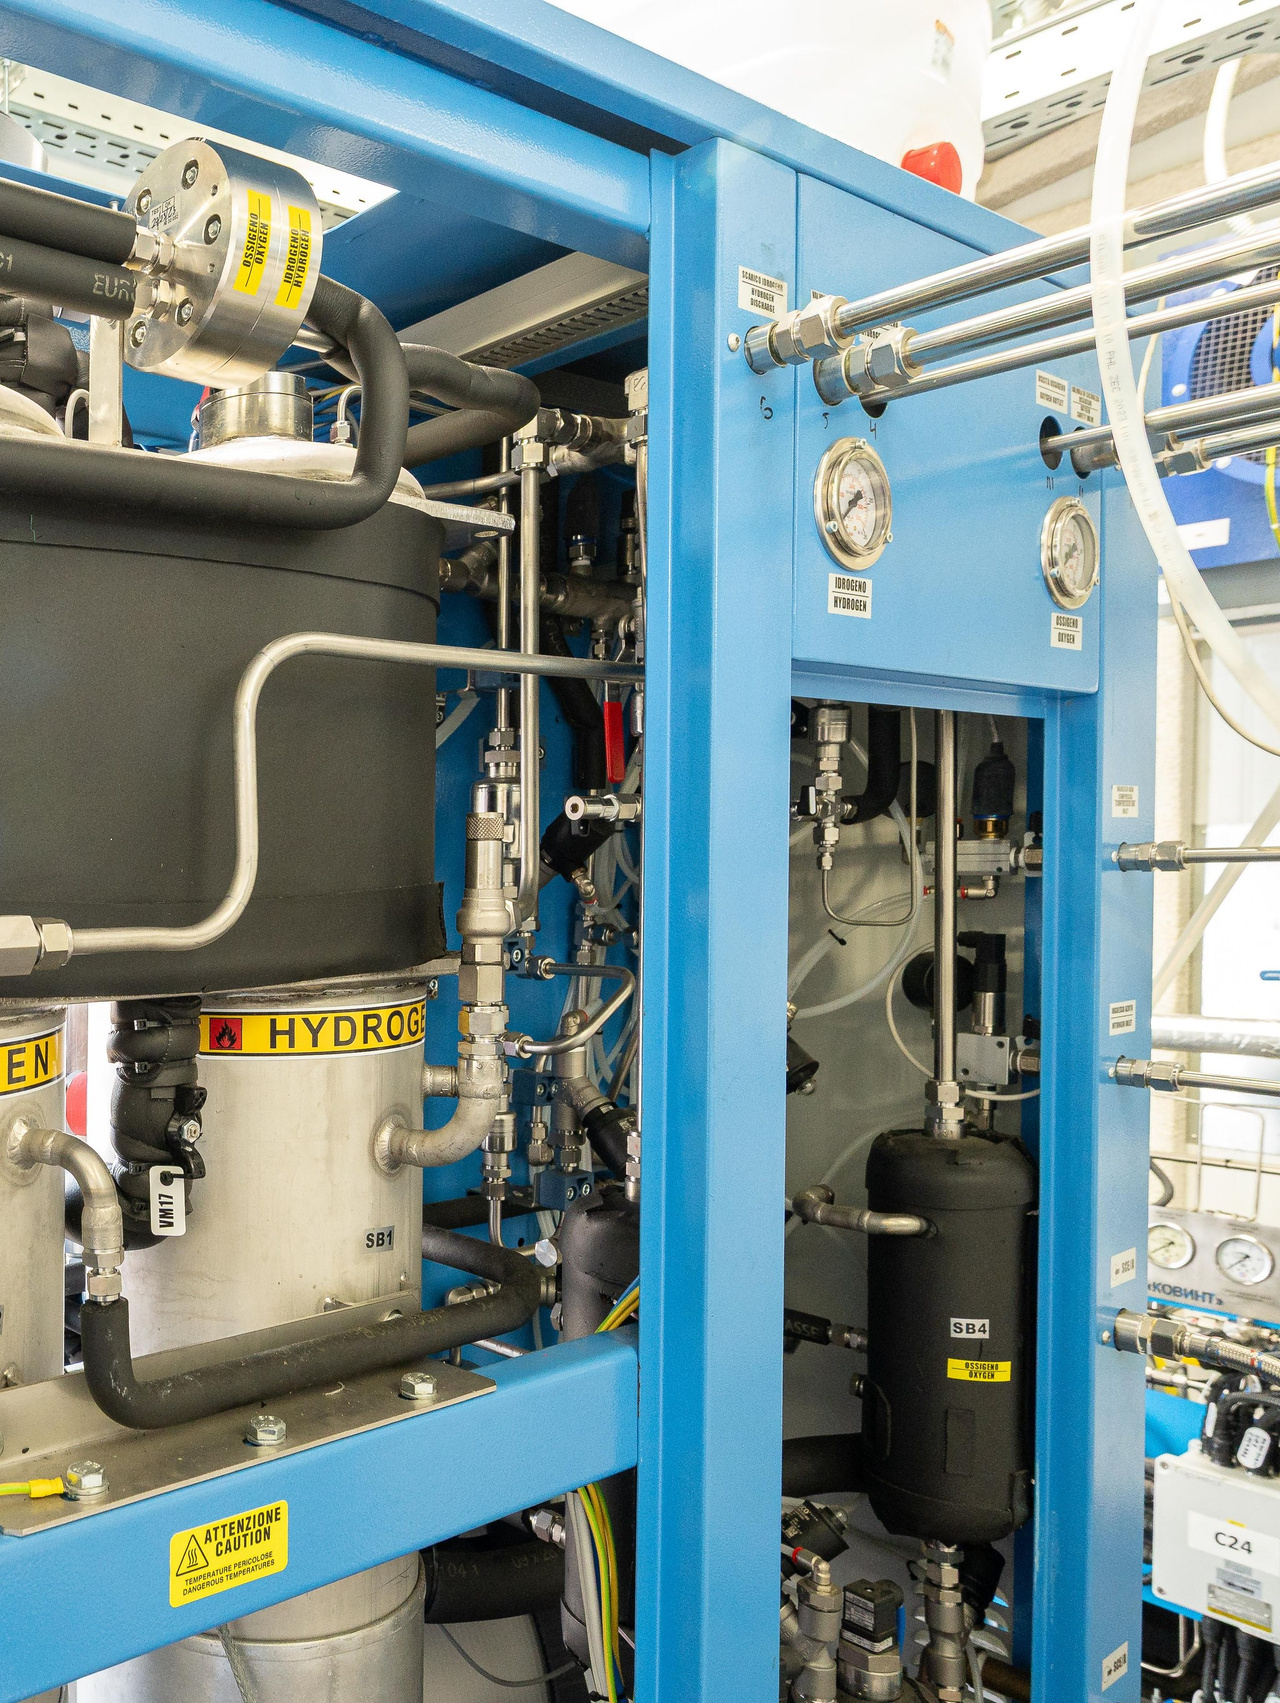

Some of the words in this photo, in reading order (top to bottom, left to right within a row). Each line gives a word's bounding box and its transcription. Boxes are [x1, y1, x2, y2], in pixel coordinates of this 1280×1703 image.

[242, 212, 259, 268] OSSIGENO
[255, 222, 269, 265] OXYGEN
[283, 228, 300, 284] IDROGENO
[293, 229, 310, 288] HYDROGEN
[92, 273, 137, 302] EUR
[751, 287, 775, 303] HYDROGEN
[750, 298, 775, 314] DISCHARGE
[834, 576, 867, 594] IDROGENO
[833, 596, 867, 612] HYDROGEN
[1056, 615, 1078, 629] OSSIGENO
[1057, 632, 1075, 644] OXYGEN
[269, 1004, 427, 1049] HYDROGE
[158, 1193, 174, 1229] VM17
[365, 1230, 393, 1249] SB1
[953, 1322, 987, 1335] SB4
[965, 1362, 999, 1371] OSSIGENO
[968, 1370, 995, 1380] OXYGEN
[204, 1506, 281, 1545] ATTENZIONE
[215, 1526, 271, 1557] CAUTION
[1214, 1531, 1253, 1555] C24
[182, 1576, 224, 1596] DANGEROUS
[225, 1558, 275, 1582] TEMPERATURES
[185, 1562, 233, 1586] TEMPERATURE
[233, 1551, 273, 1573] PERICOLOSE
